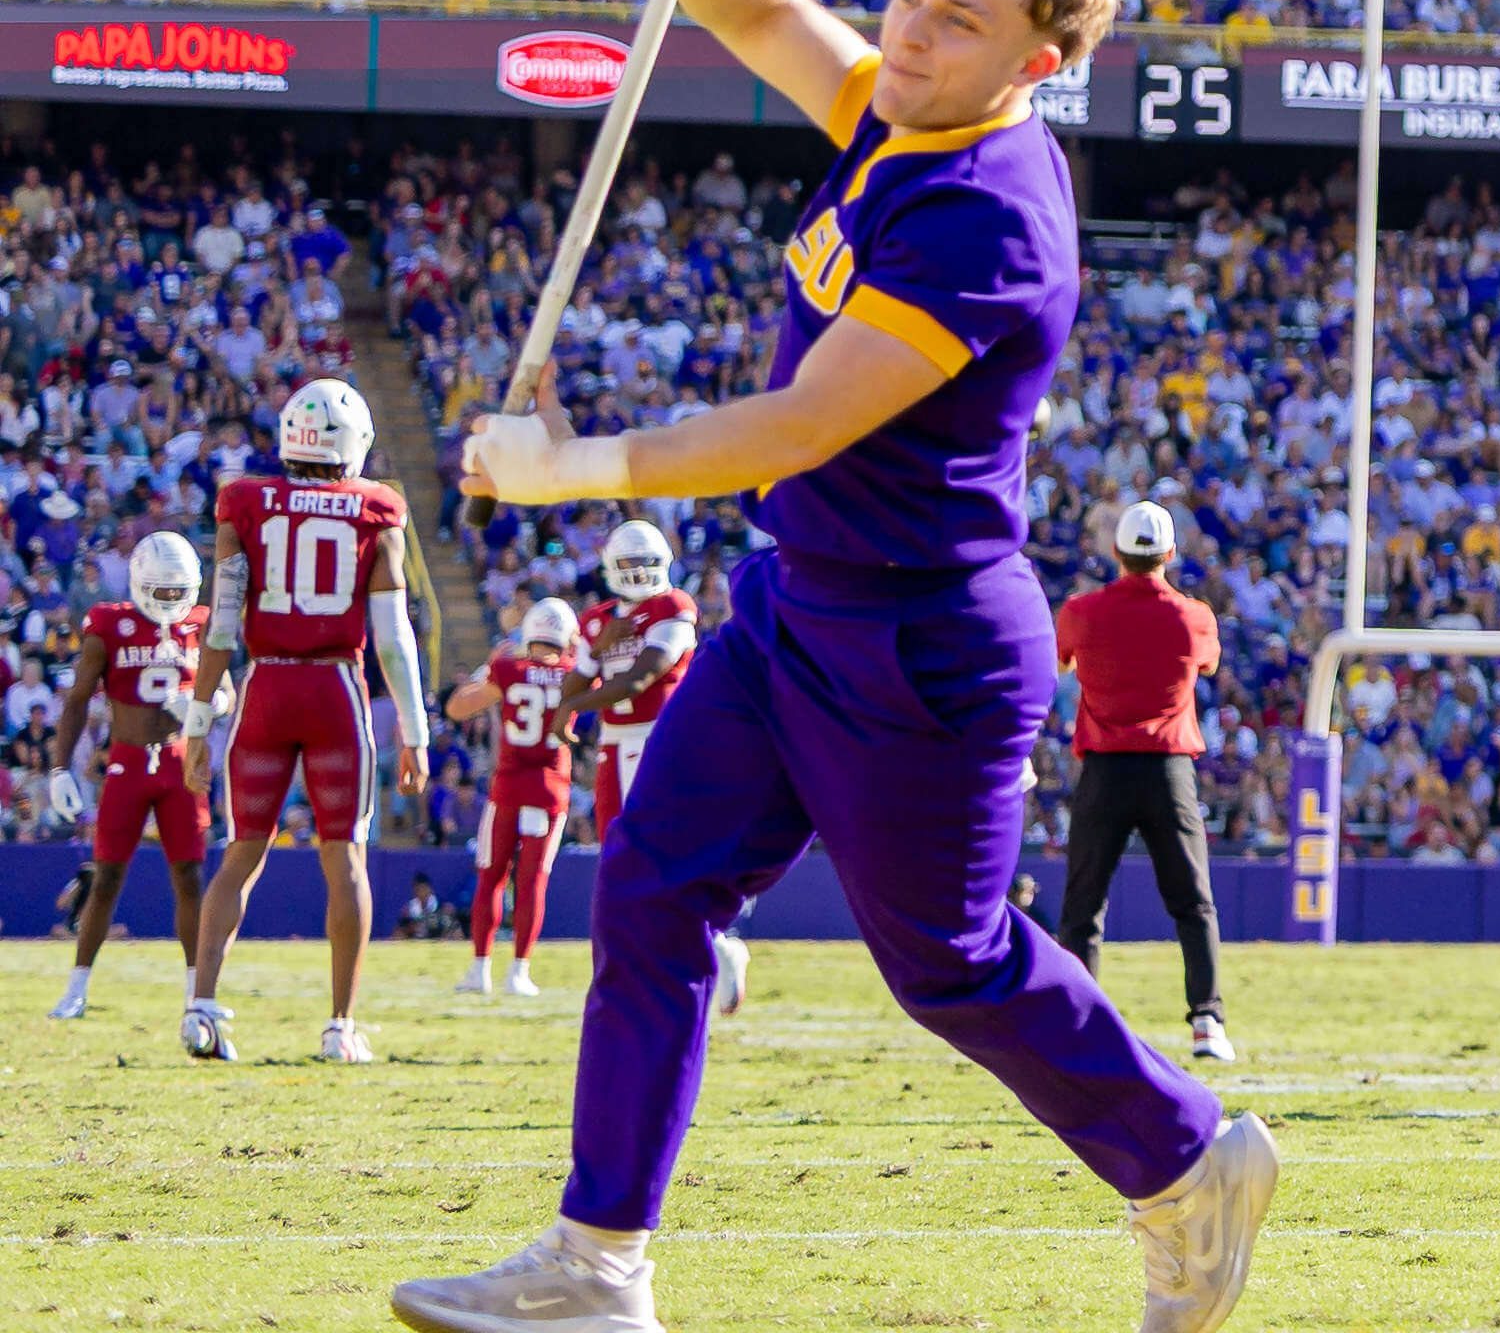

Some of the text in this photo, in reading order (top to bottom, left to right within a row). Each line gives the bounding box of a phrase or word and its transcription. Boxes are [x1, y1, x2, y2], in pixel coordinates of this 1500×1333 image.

[54, 21, 155, 69] PAPA
[506, 51, 625, 89] Community
[1140, 63, 1232, 137] 25
[261, 486, 363, 518] T. GREEN
[257, 515, 359, 617] 10
